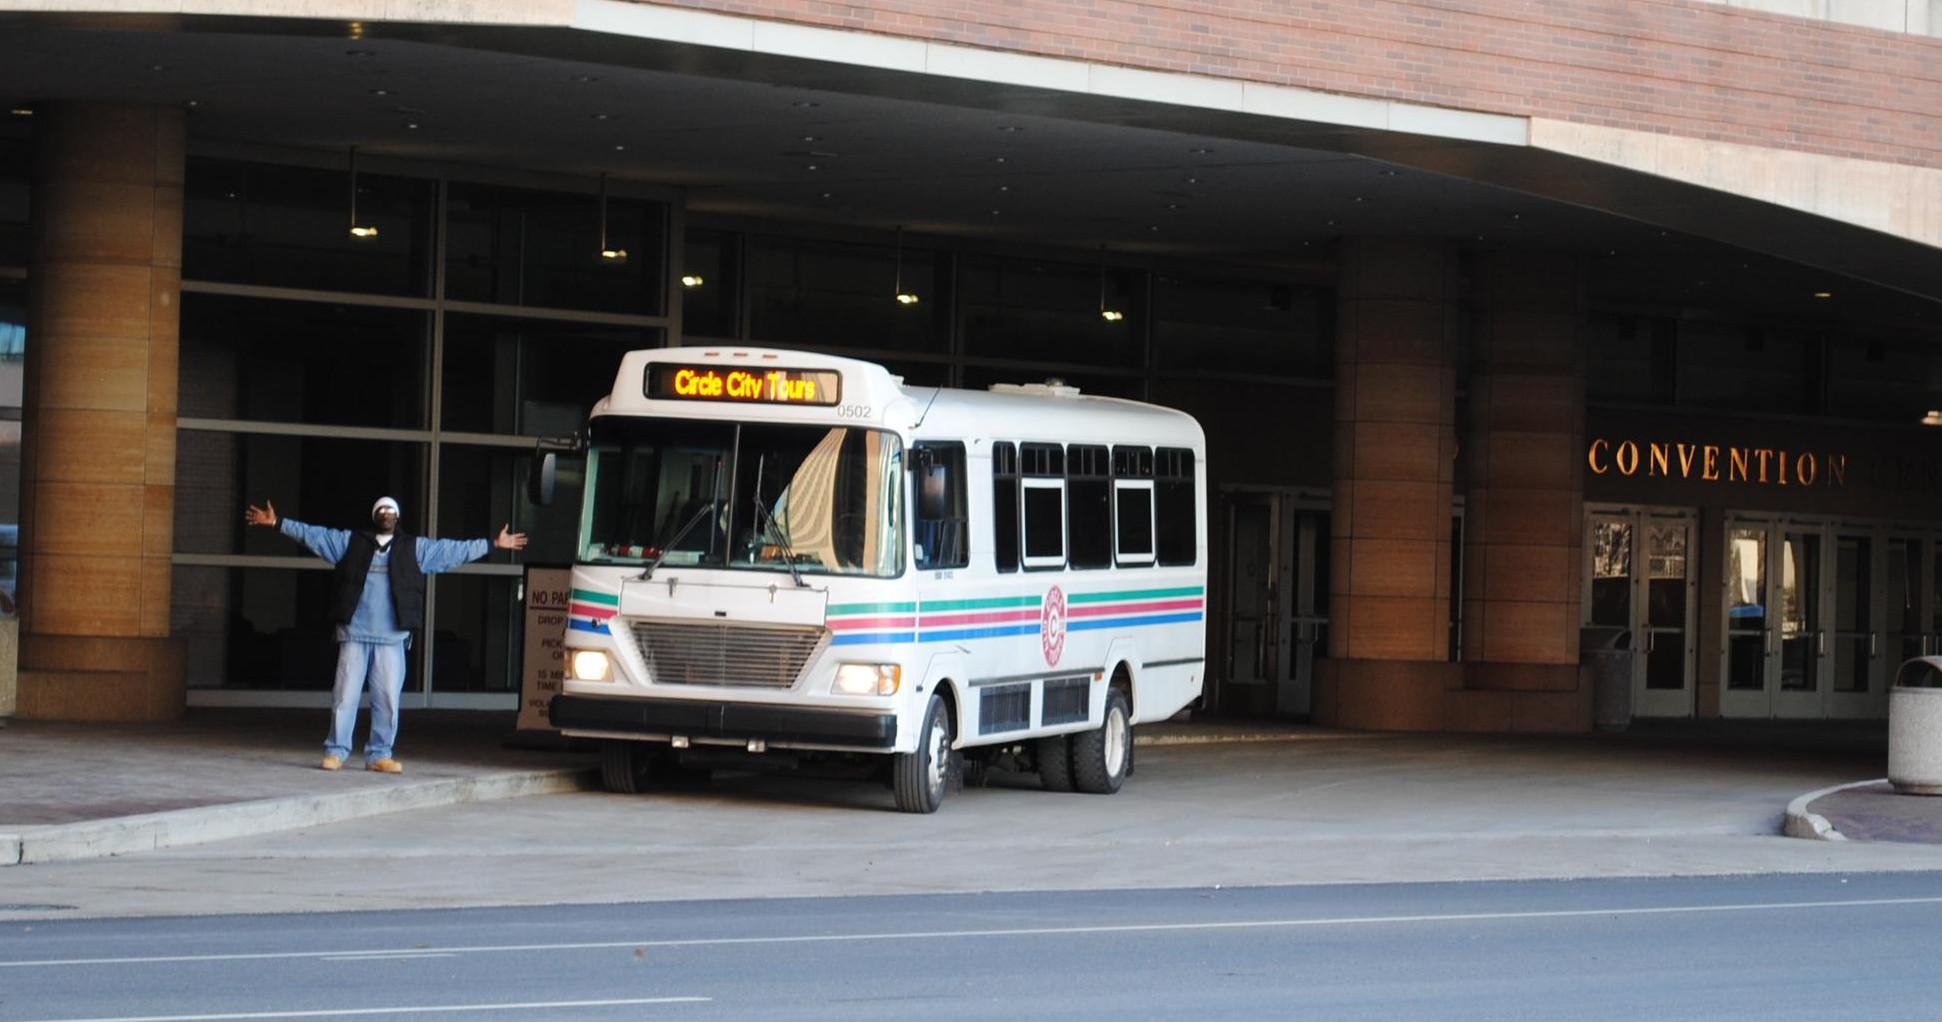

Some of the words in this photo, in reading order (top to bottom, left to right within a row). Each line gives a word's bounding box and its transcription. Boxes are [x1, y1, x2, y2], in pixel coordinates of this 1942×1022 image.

[675, 369, 722, 395] Circle
[726, 371, 762, 399] City
[768, 373, 815, 399] Tours
[837, 405, 872, 418] 0502
[1588, 438, 1846, 487] CONVENTION
[531, 591, 547, 604] NO
[538, 615, 563, 625] DROP
